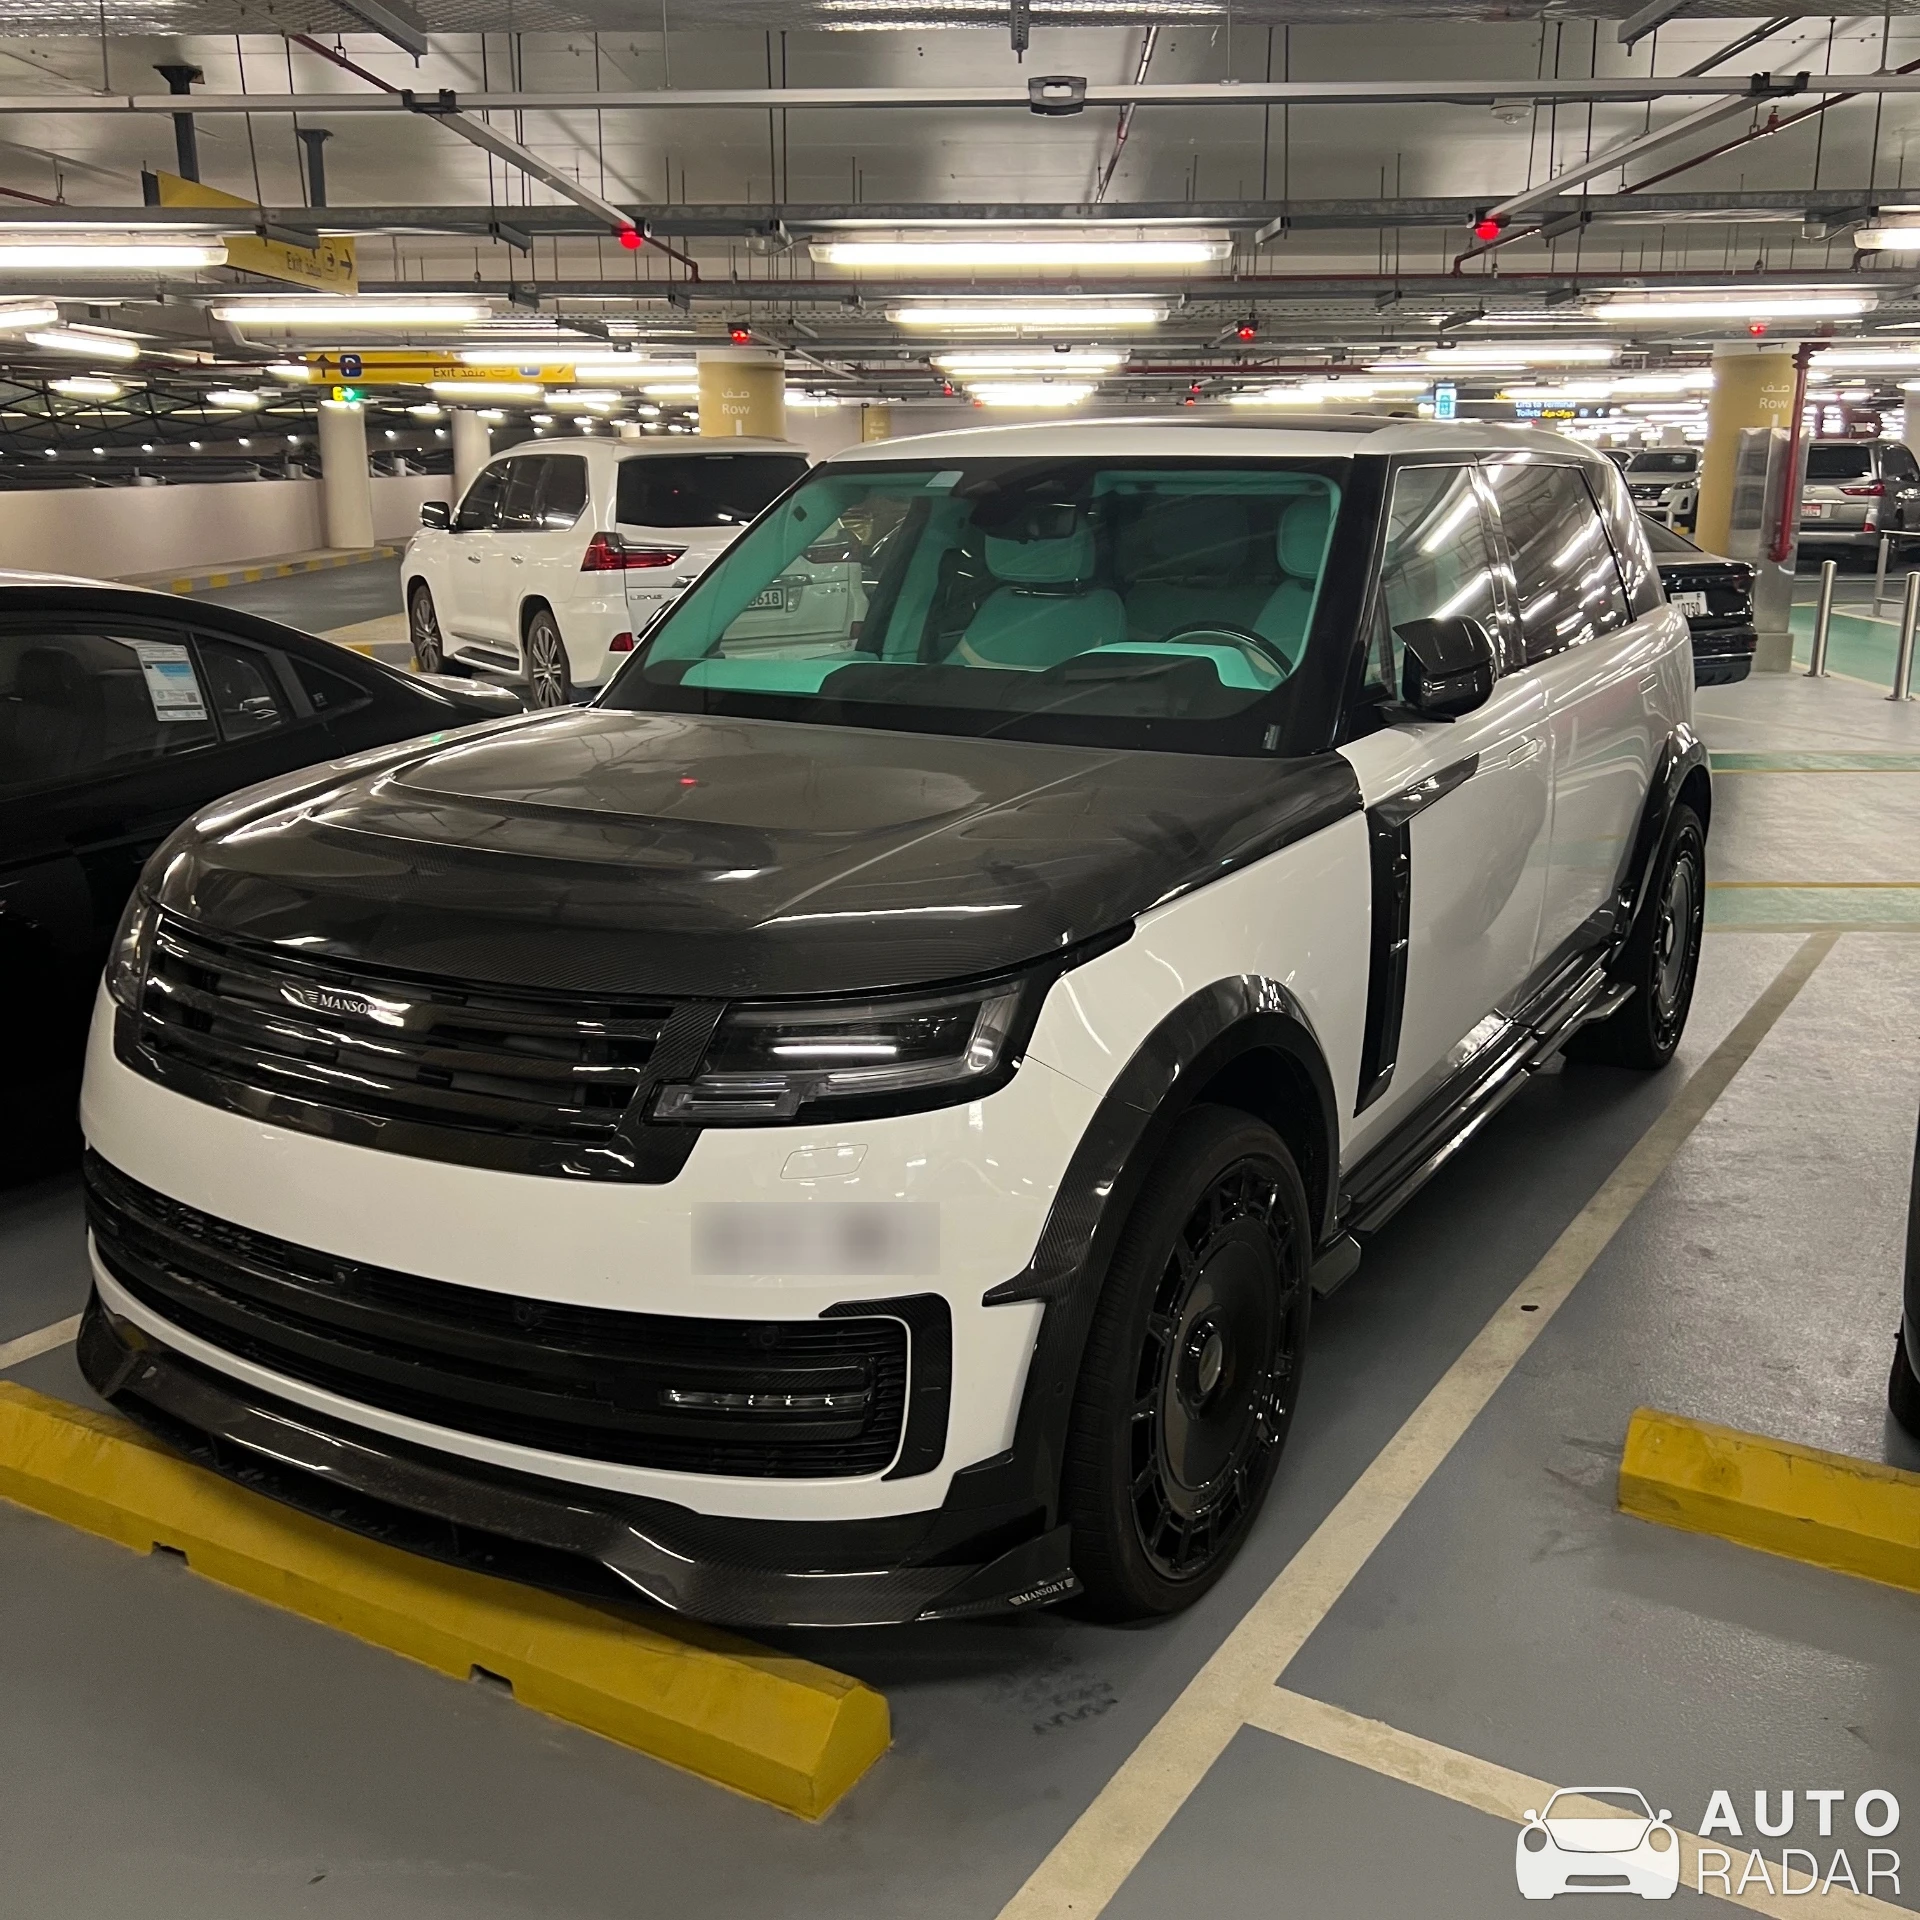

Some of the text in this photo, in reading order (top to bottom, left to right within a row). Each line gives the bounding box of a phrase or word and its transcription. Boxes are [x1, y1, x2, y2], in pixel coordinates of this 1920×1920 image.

[286, 251, 303, 273] Exit
[433, 366, 456, 377] Exit
[1759, 397, 1789, 409] Row
[722, 404, 750, 415] Row
[1516, 409, 1541, 417] Toilets
[320, 994, 386, 1018] MANSOR
[1019, 1581, 1065, 1602] MANSORY
